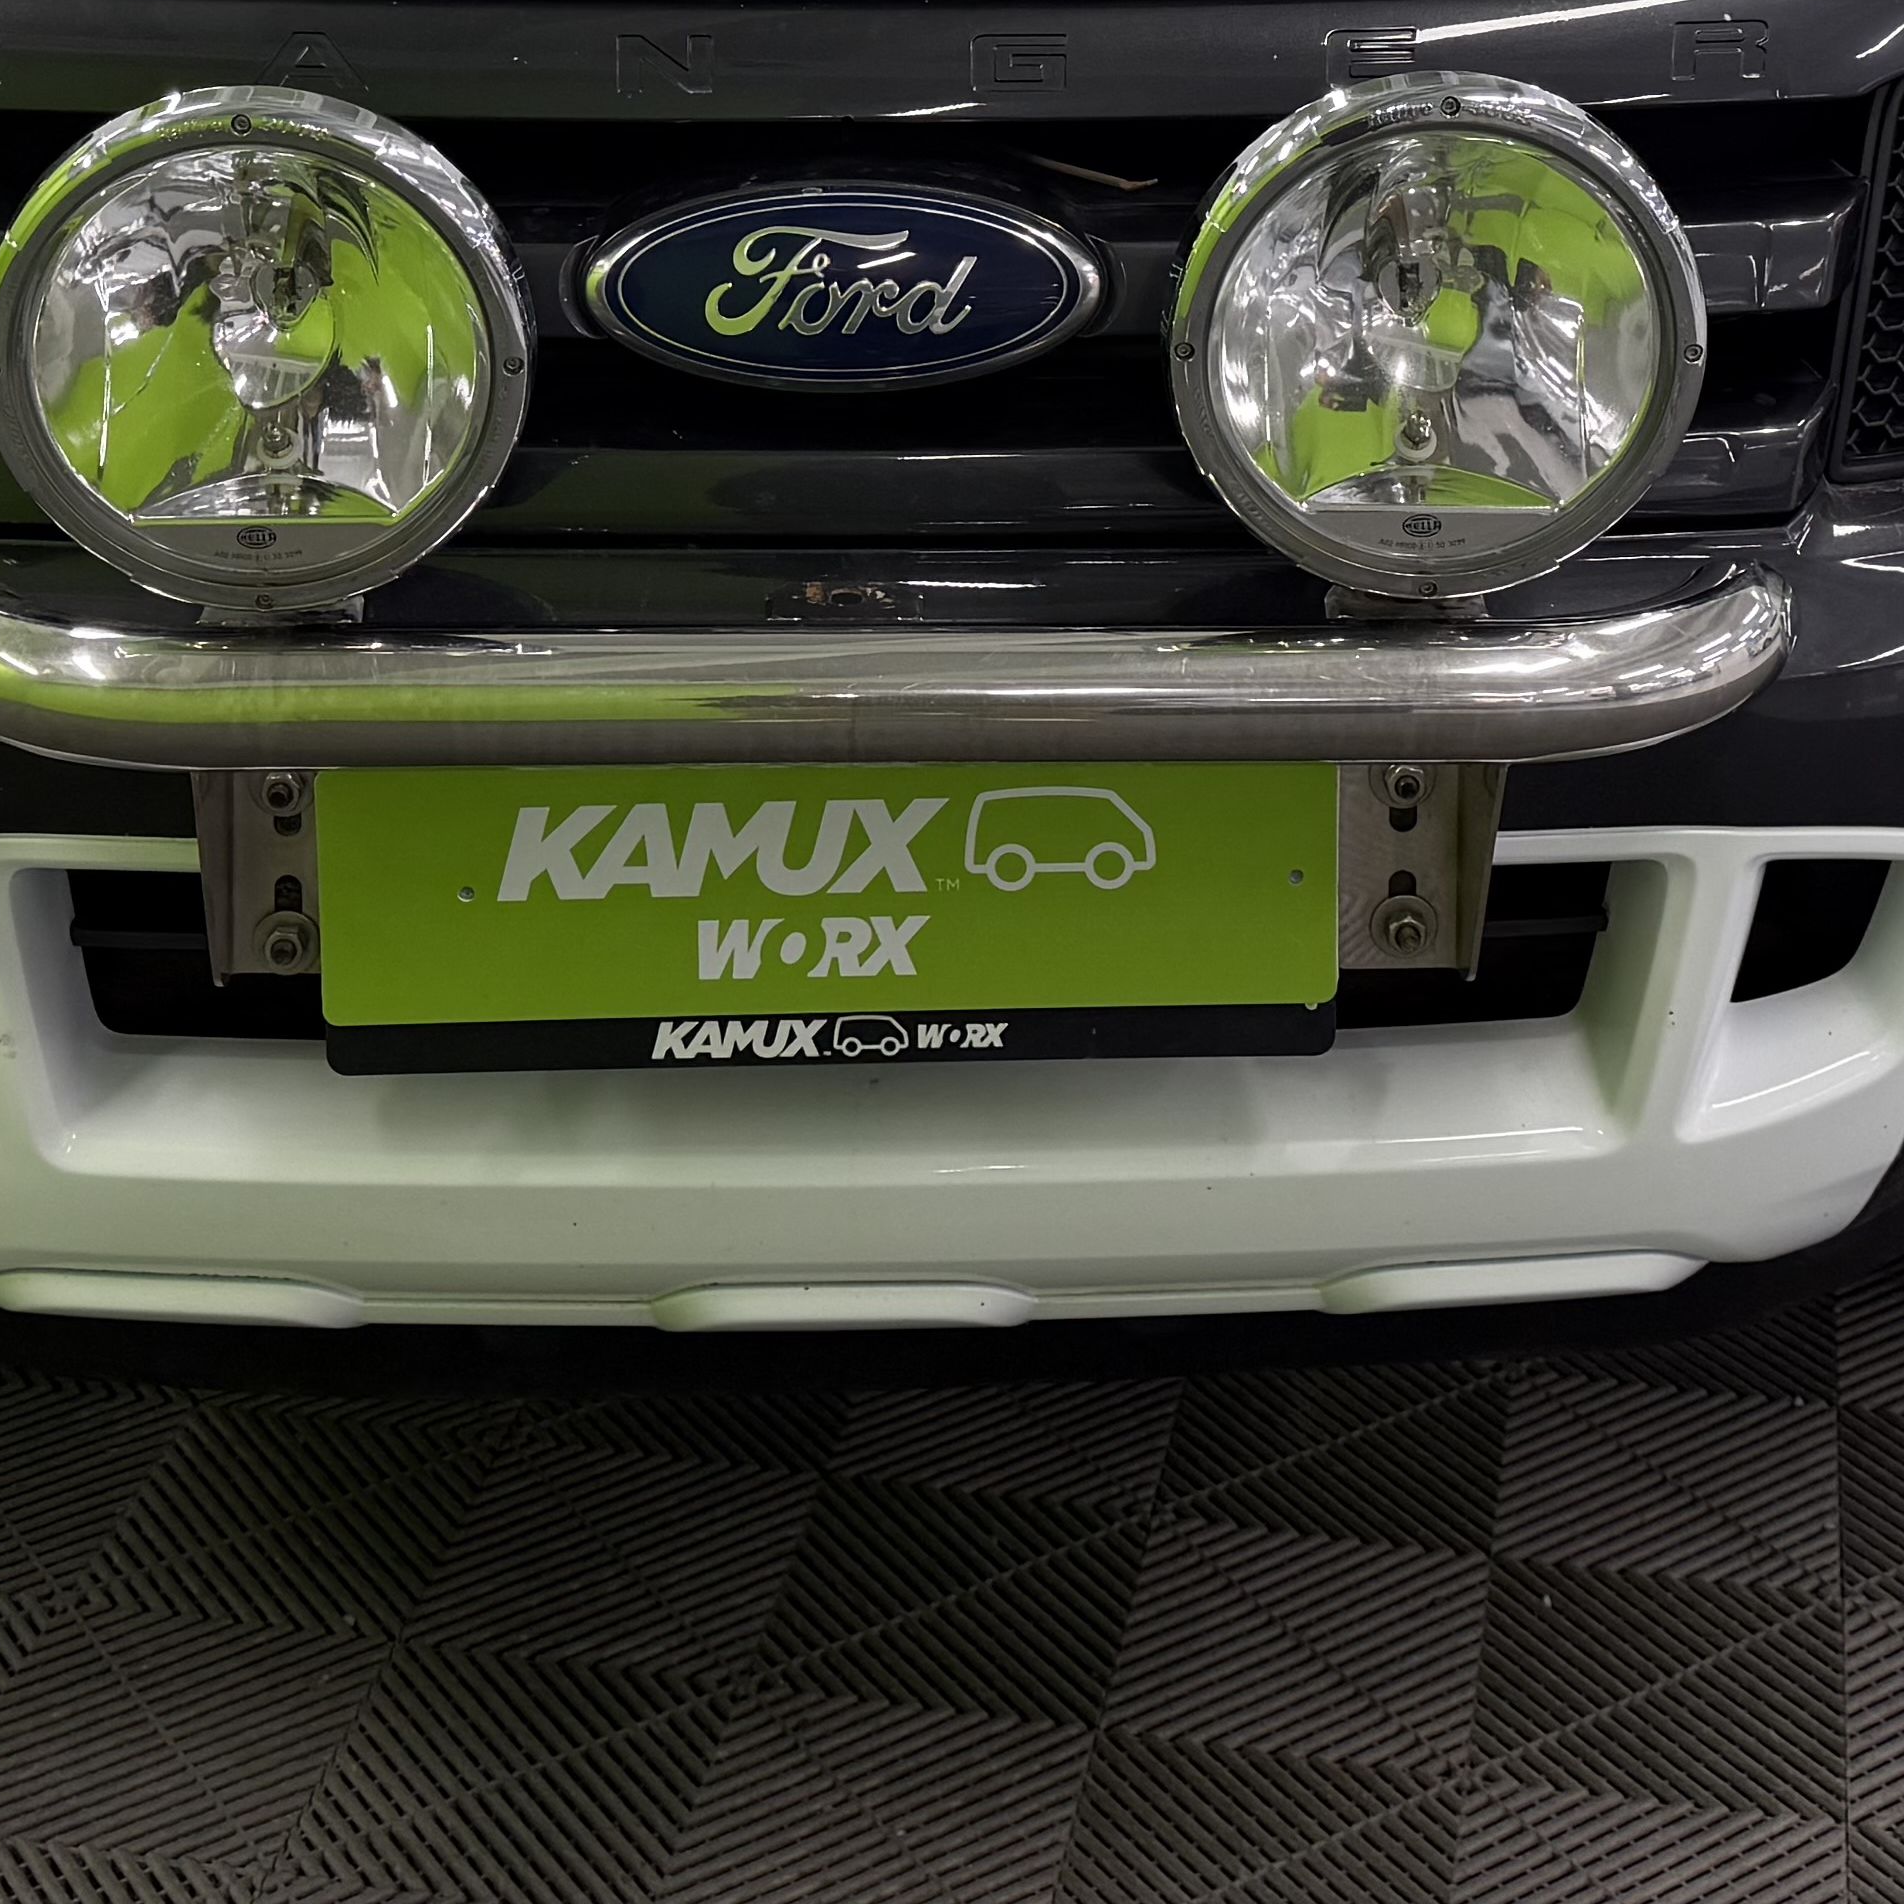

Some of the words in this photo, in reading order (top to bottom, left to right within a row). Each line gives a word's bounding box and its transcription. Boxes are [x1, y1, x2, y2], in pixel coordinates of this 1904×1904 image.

[704, 225, 977, 336] Ford
[498, 799, 949, 901] KAMUX
[698, 916, 930, 980] WORX
[652, 1019, 828, 1059] KAMUX
[918, 1023, 1008, 1048] WORX
